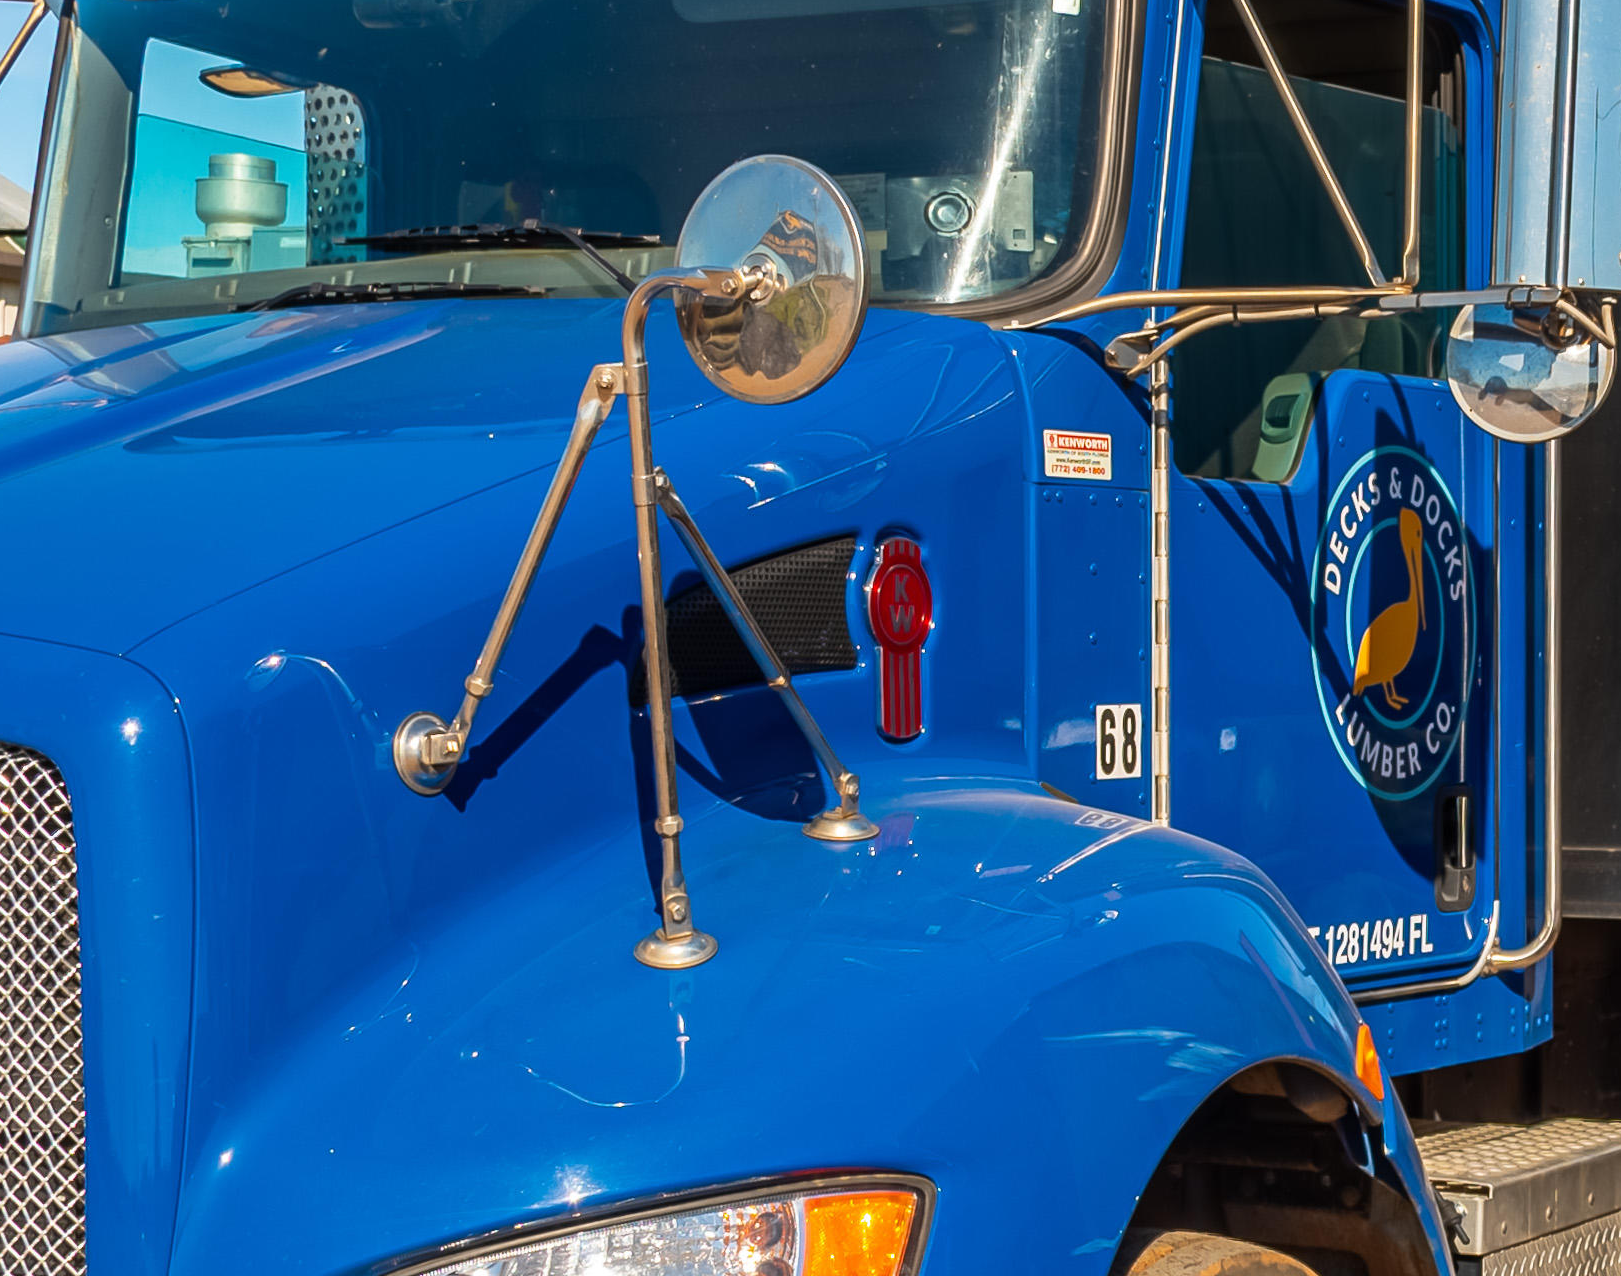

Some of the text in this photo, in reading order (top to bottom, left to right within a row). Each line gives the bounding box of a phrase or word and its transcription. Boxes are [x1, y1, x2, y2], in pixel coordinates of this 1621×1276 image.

[1058, 436, 1108, 451] KENWORTH
[1323, 466, 1464, 600] DECKS & DOCKS
[1100, 708, 1137, 775] 68
[1335, 692, 1456, 779] LUMBER CO.
[1325, 914, 1434, 966] 1281494 FL
